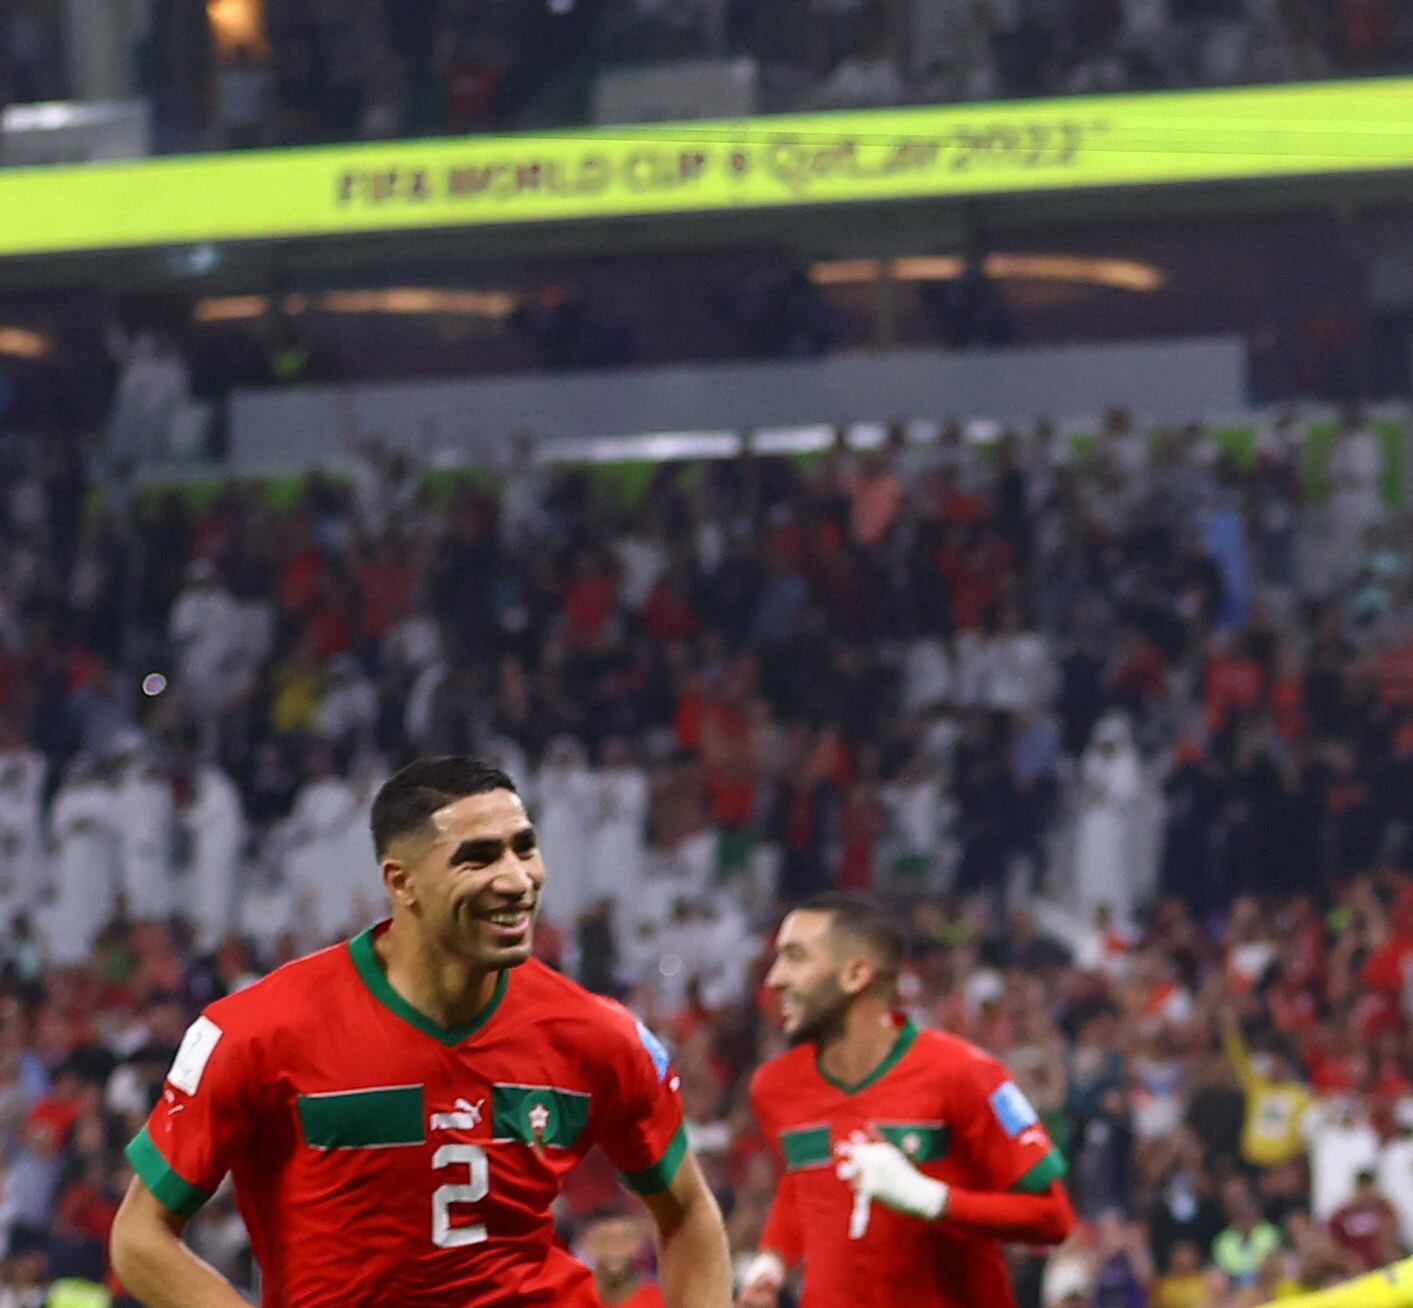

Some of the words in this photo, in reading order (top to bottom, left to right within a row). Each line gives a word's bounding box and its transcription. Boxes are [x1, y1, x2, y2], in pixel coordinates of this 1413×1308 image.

[338, 167, 430, 203] FIFA
[446, 154, 612, 197] WORLD
[623, 149, 706, 192] CUP
[431, 1143, 489, 1248] 2
